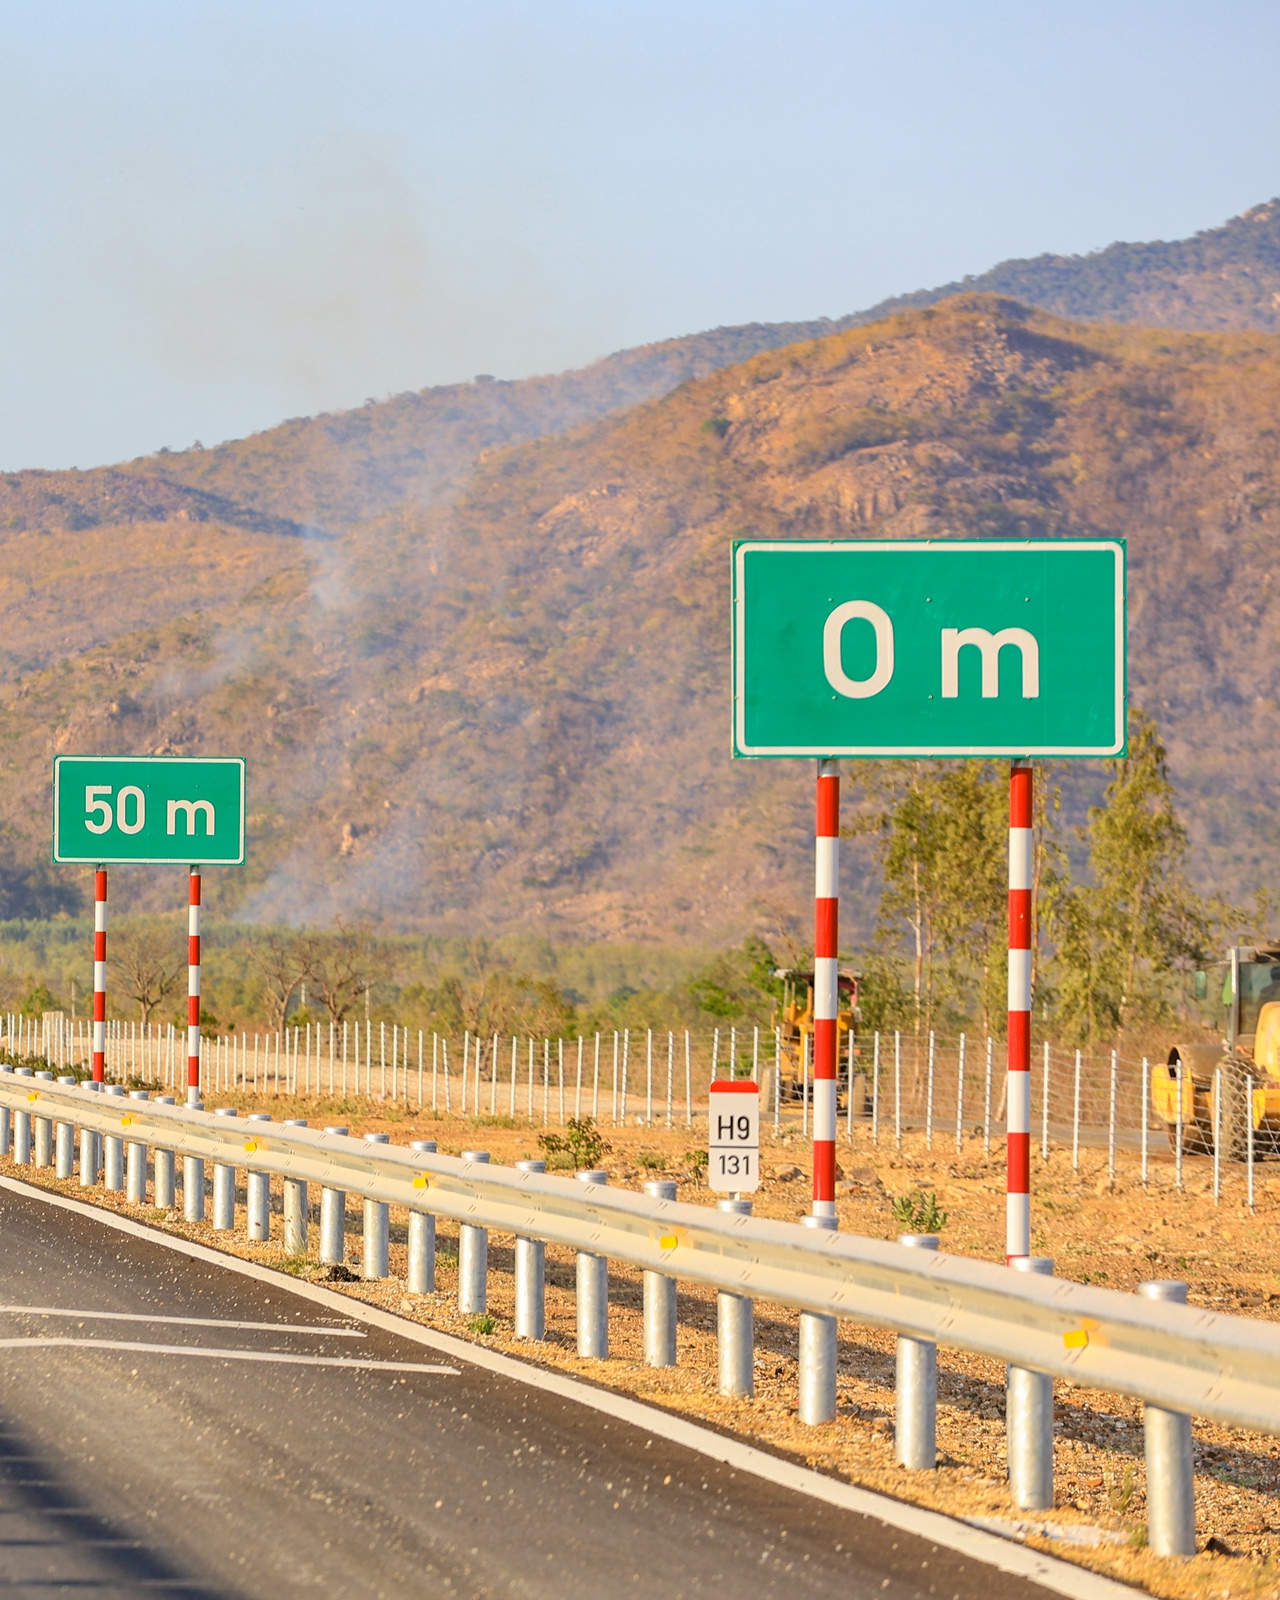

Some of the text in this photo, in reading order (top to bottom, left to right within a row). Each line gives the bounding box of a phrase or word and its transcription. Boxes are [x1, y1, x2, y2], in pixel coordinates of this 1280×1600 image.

[823, 599, 1040, 699] 0 m
[84, 784, 215, 836] 50 m
[717, 1115, 750, 1140] H9
[719, 1155, 750, 1175] 131
